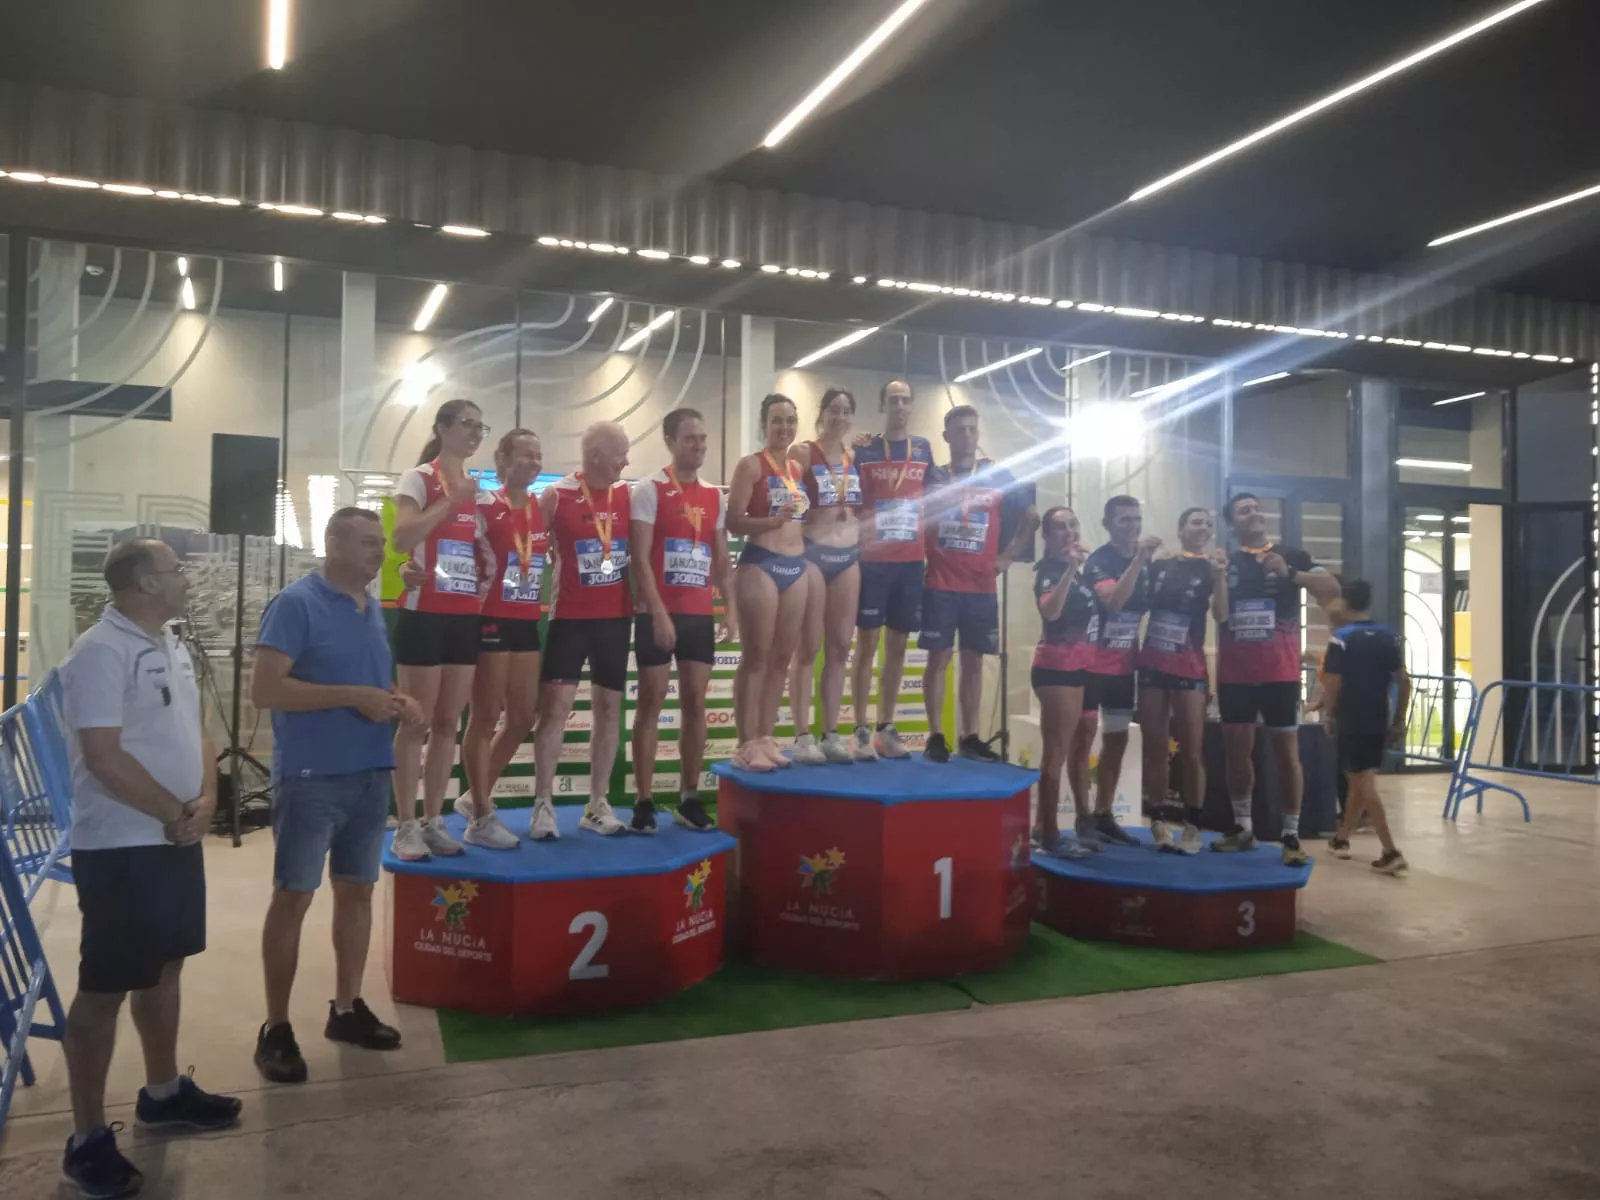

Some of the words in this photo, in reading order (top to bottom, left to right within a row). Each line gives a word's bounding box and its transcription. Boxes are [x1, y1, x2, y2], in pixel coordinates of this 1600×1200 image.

[933, 856, 953, 919] 1
[420, 927, 434, 941] LA
[1237, 900, 1256, 937] 3
[568, 909, 609, 980] 2
